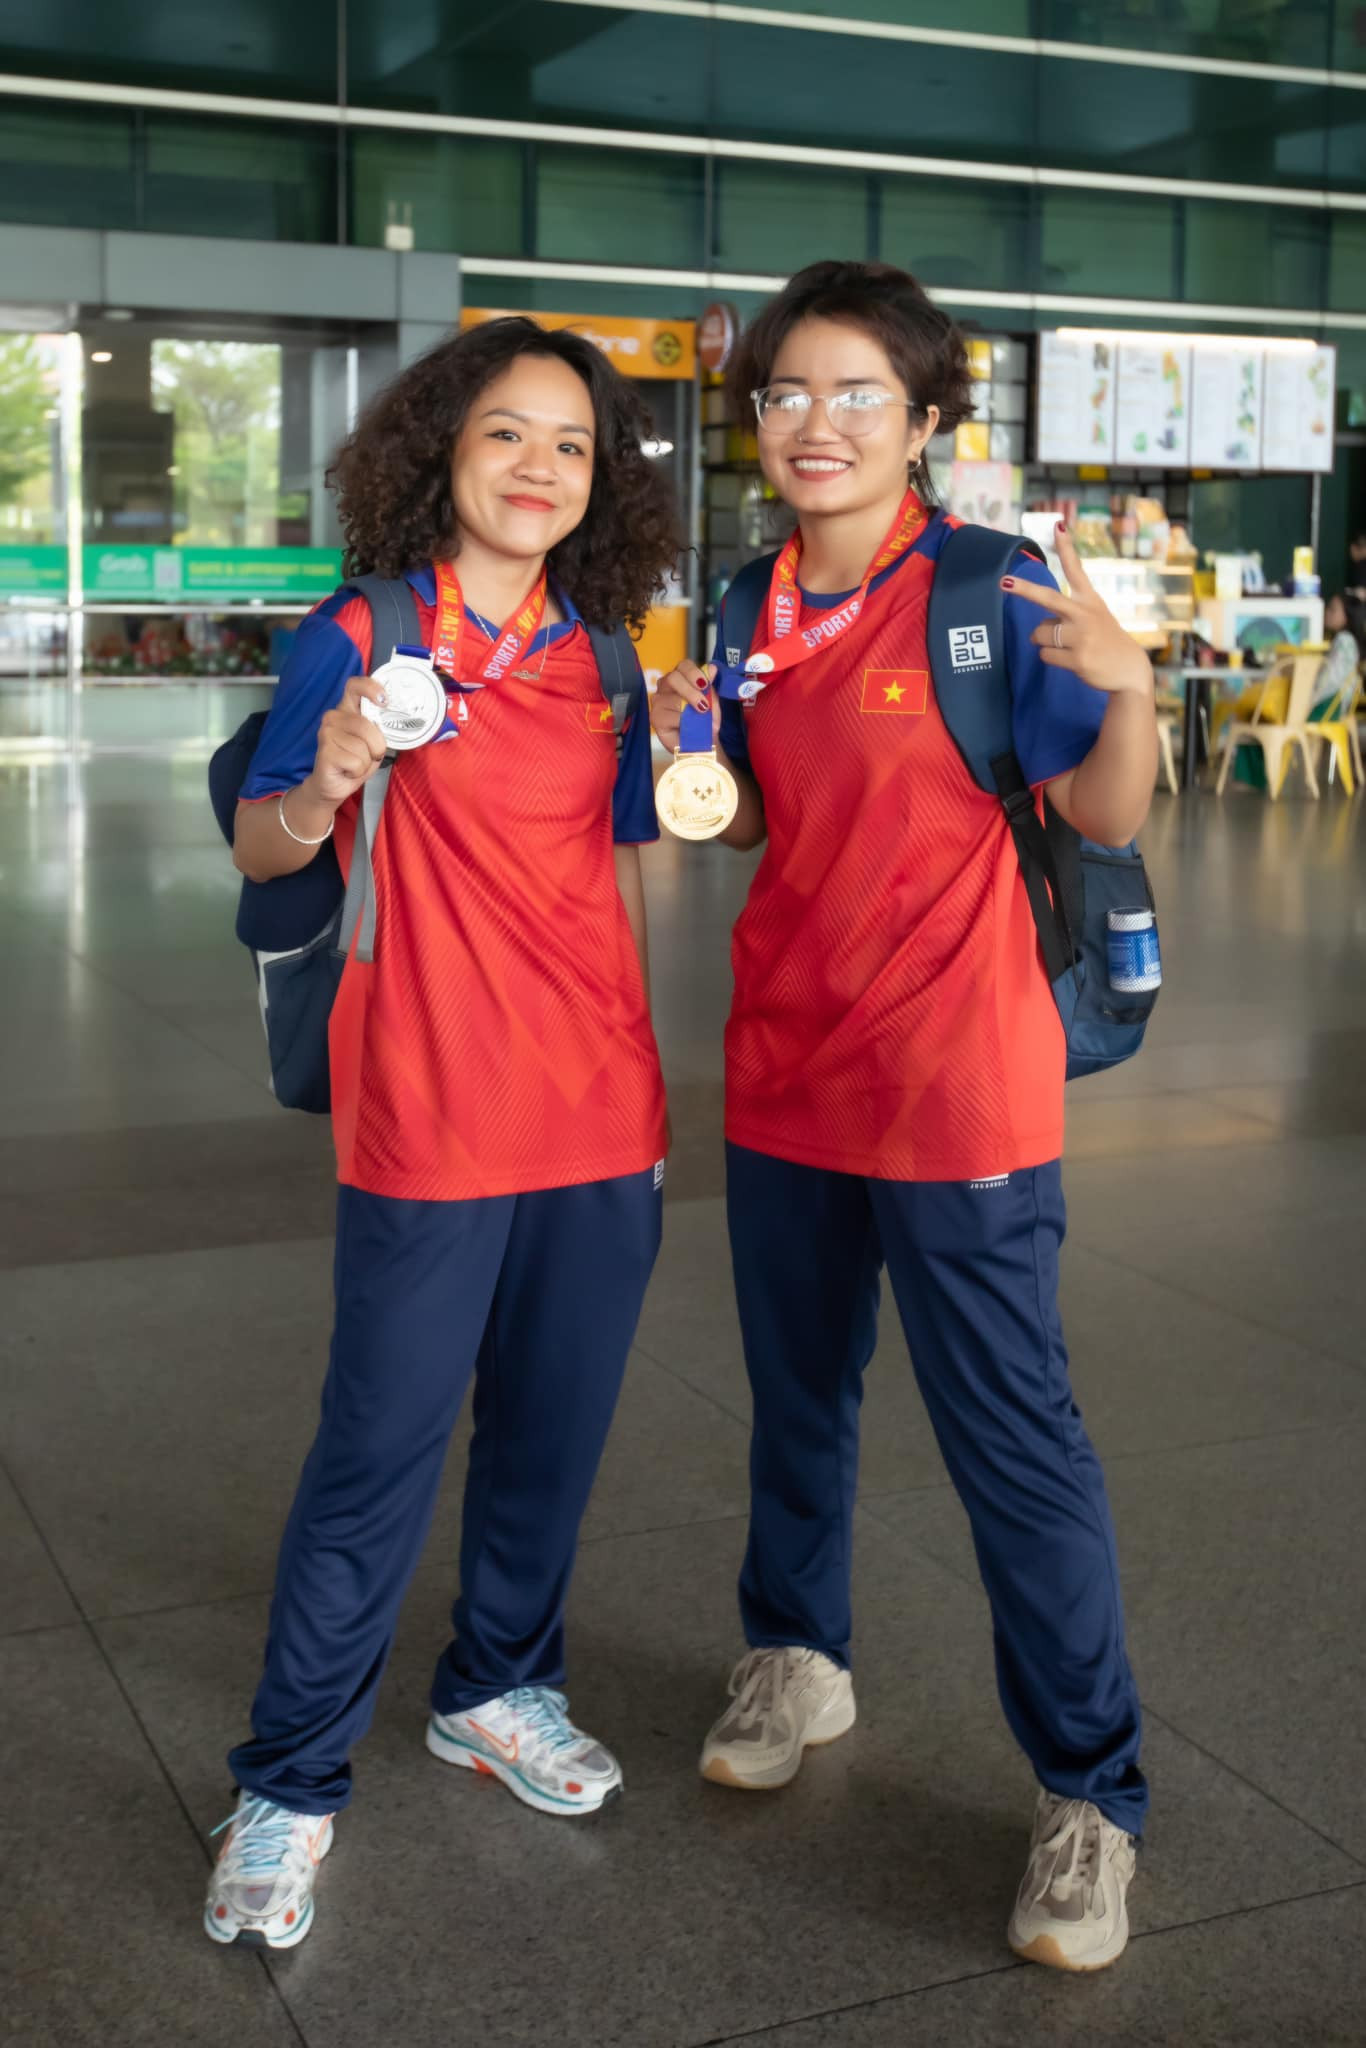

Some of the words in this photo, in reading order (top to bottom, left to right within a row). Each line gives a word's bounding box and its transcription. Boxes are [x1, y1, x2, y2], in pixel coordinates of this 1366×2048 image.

[802, 600, 861, 649] SPORTS
[954, 630, 985, 646] JG
[955, 647, 987, 662] BL
